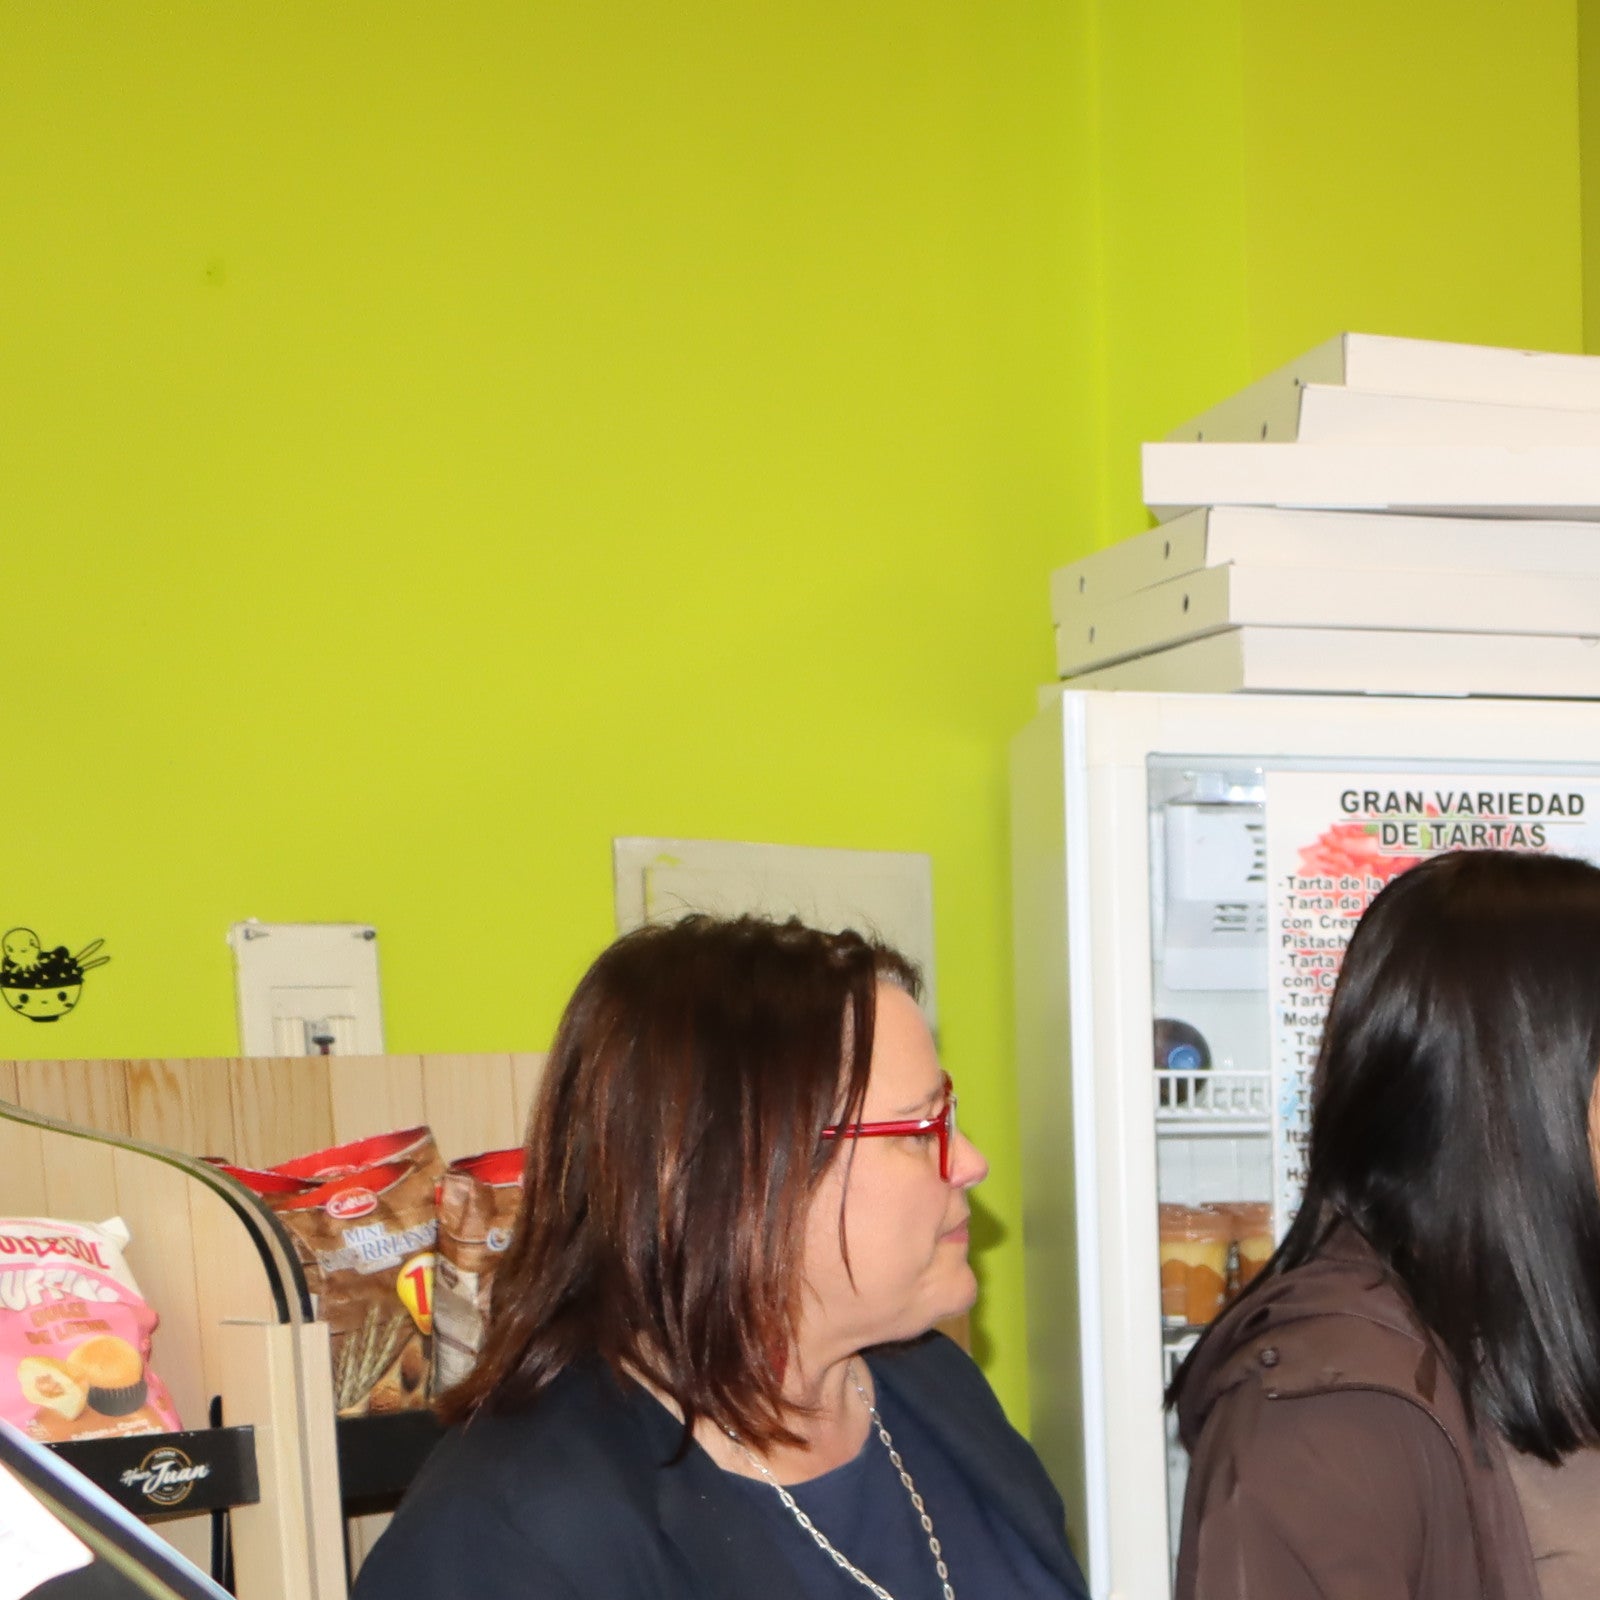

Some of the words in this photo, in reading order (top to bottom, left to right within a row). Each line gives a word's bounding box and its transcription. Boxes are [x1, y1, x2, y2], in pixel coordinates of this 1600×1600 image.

[1340, 790, 1424, 815] GRAN
[1434, 792, 1586, 816] VARIEDAD
[1381, 823, 1419, 847] DE
[1432, 823, 1547, 848] TARTAS
[1340, 876, 1361, 890] de
[1366, 876, 1382, 890] la
[1340, 896, 1361, 910] de
[1281, 919, 1313, 930] con
[1282, 978, 1315, 988] con
[141, 1460, 209, 1495] Juan
